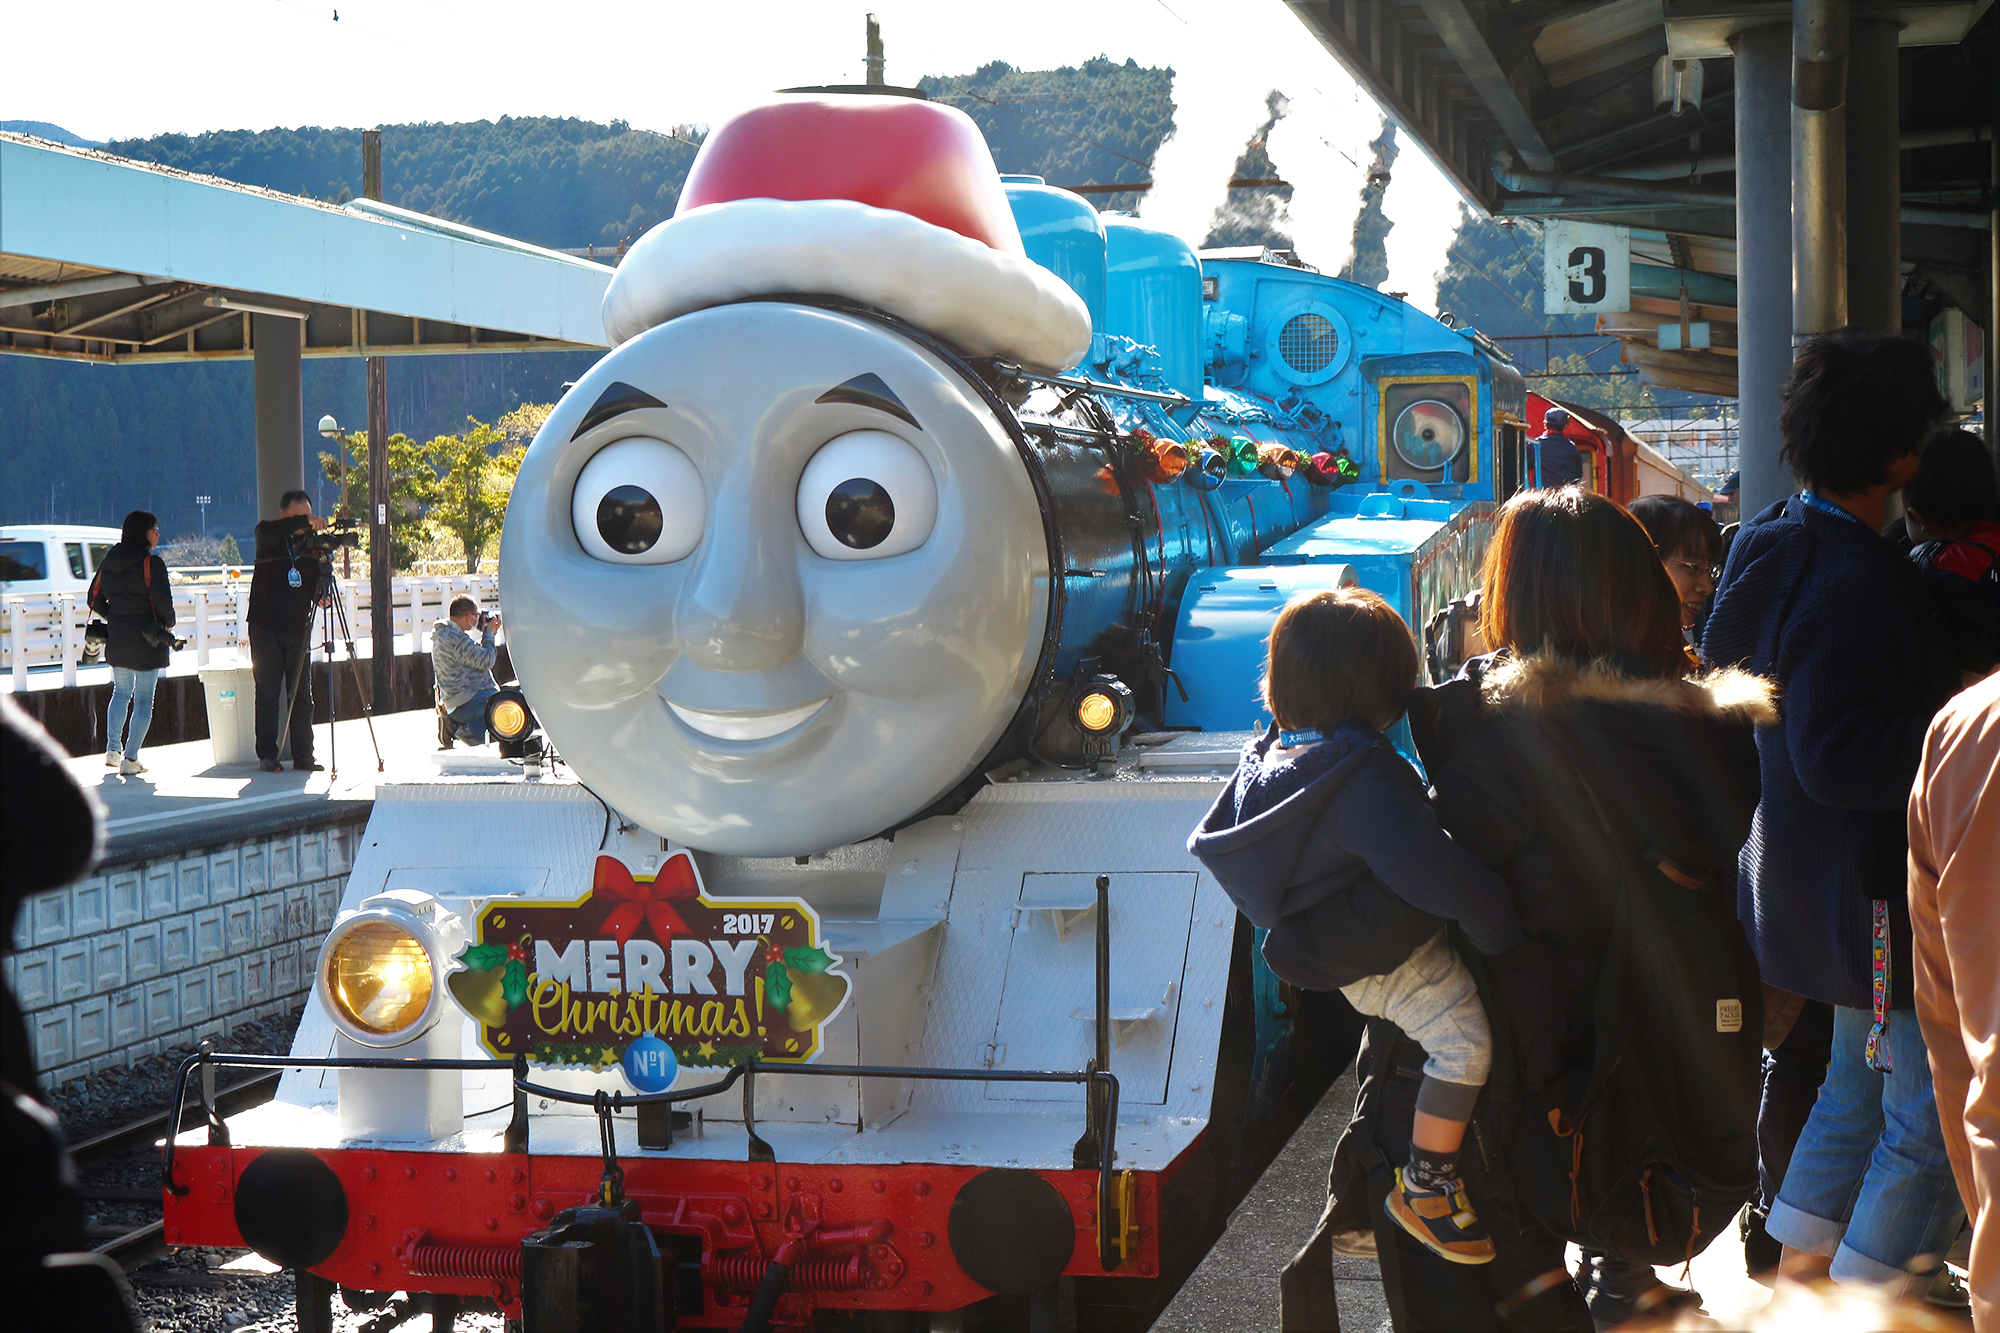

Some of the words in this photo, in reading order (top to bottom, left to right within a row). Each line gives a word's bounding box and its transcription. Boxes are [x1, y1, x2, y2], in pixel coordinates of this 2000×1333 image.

[1568, 246, 1607, 304] 3
[1288, 731, 1323, 743] 大井川
[722, 913, 775, 934] 2017
[534, 939, 759, 996] MERRY
[526, 972, 766, 1037] Christmas!
